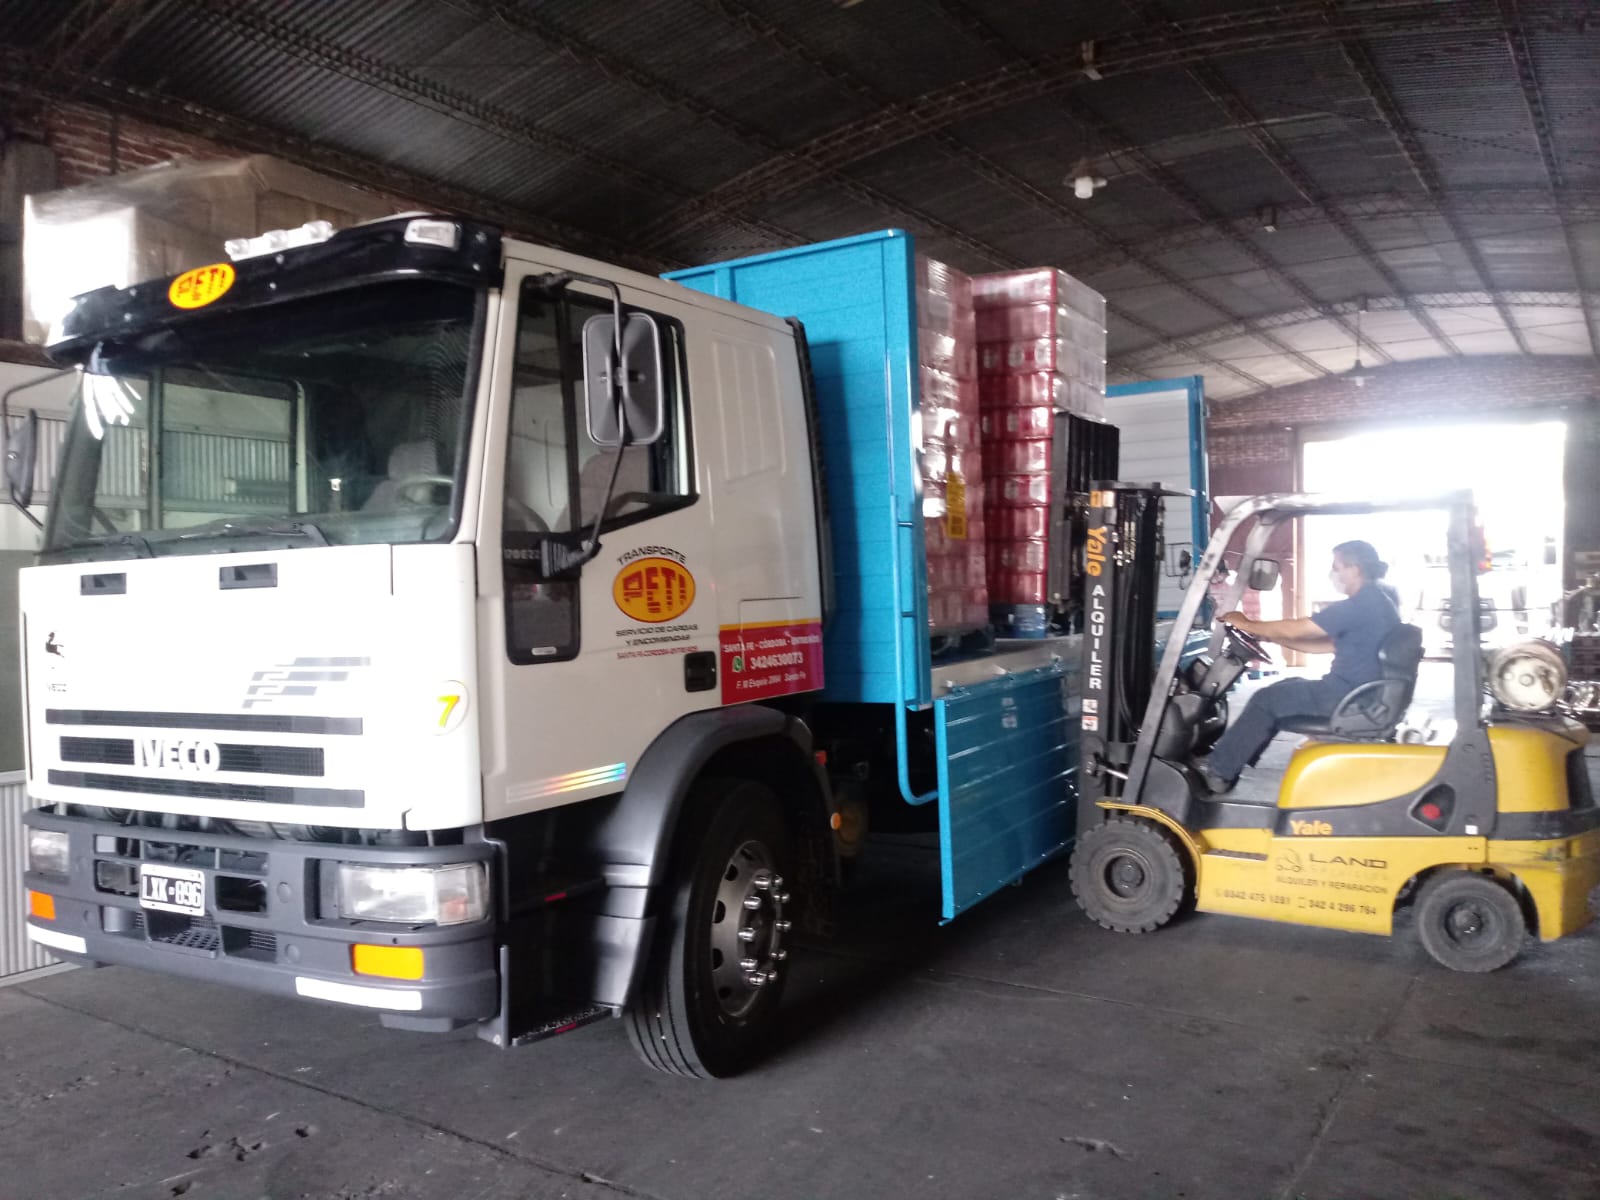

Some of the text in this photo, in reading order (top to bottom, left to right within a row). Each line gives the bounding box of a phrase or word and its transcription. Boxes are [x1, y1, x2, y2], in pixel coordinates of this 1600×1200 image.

[616, 545, 687, 565] TRANSPORTE
[1087, 526, 1107, 577] Yale
[622, 566, 687, 613] PETI
[616, 627, 654, 637] SERVICIO
[666, 623, 698, 633] CARGAS
[1089, 584, 1105, 689] ALQUILER
[437, 694, 460, 728] 7
[133, 738, 220, 771] IVECO
[1290, 820, 1332, 836] Yale
[1309, 853, 1388, 869] LAND
[1276, 876, 1318, 887] ALQUILER
[1309, 899, 1326, 909] 342
